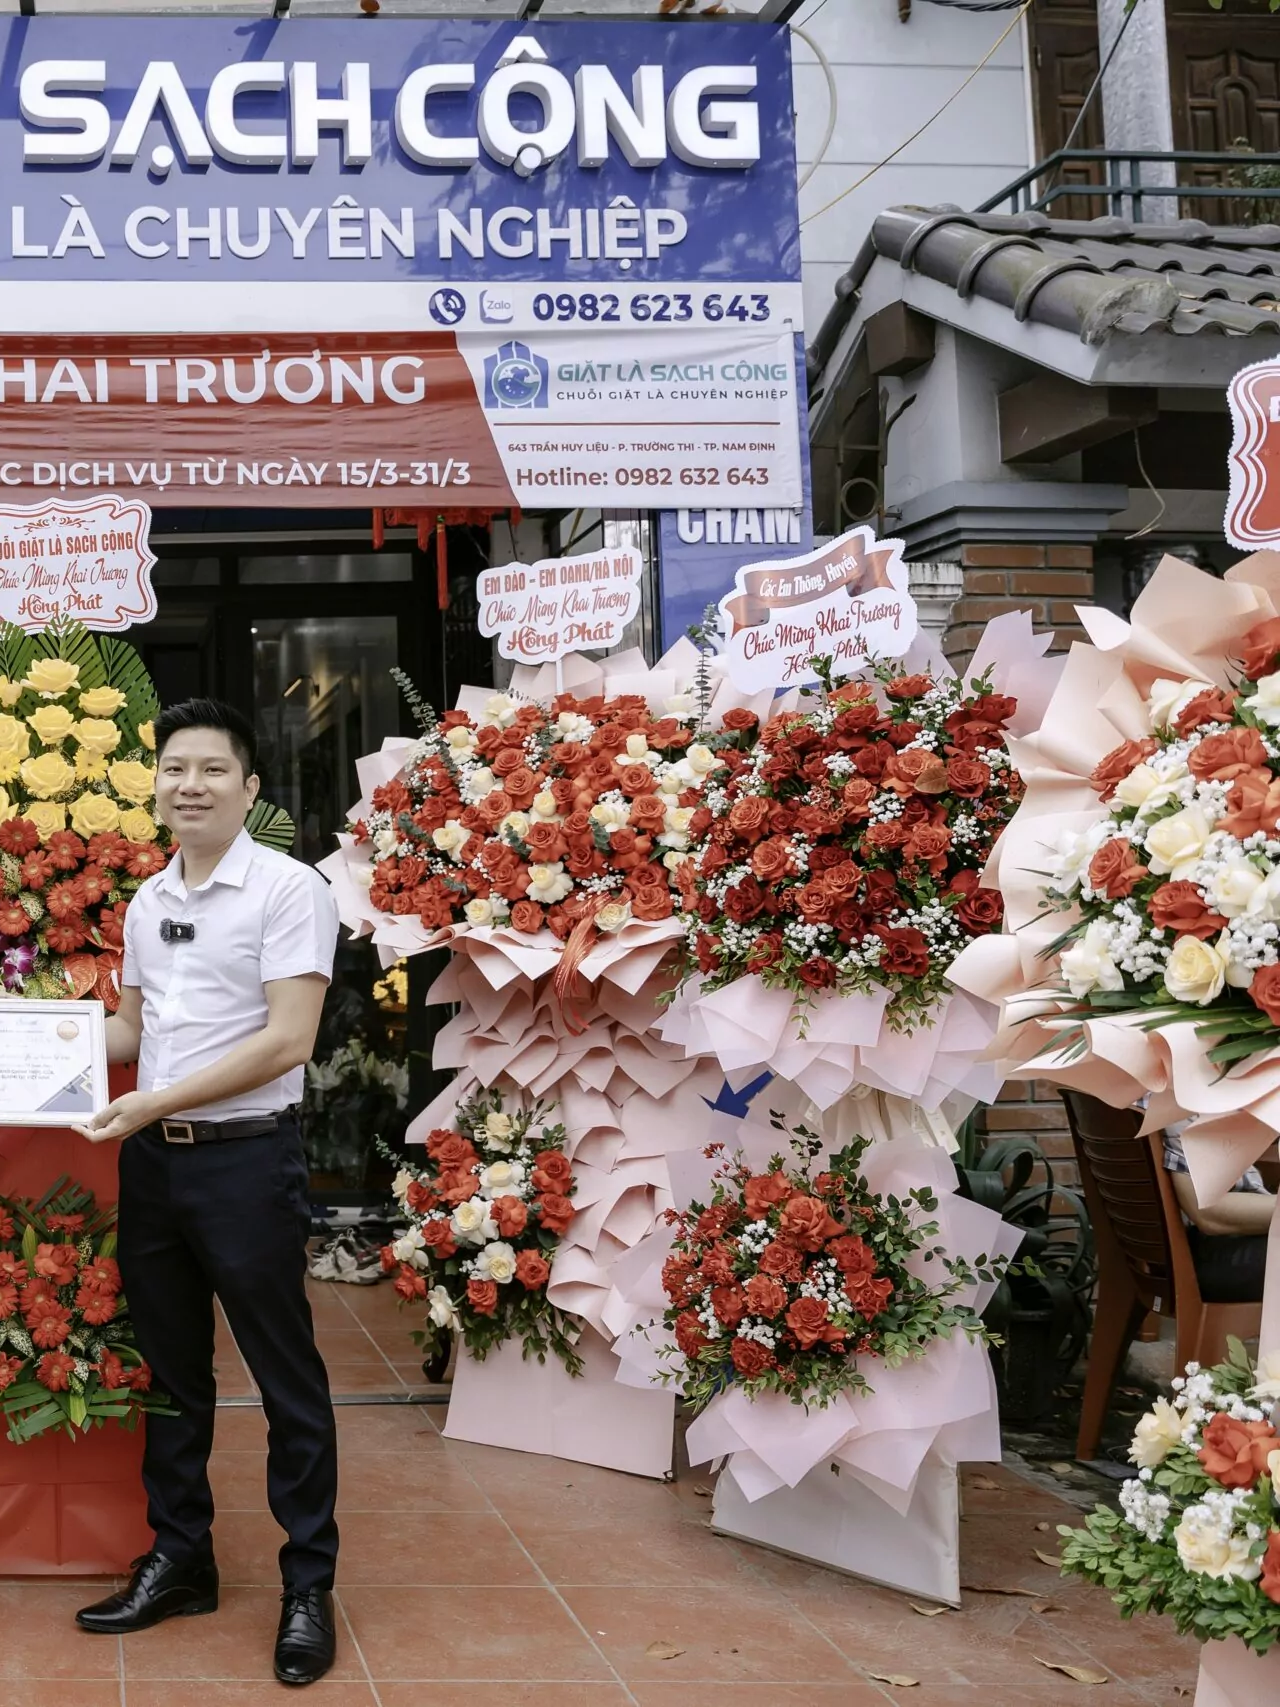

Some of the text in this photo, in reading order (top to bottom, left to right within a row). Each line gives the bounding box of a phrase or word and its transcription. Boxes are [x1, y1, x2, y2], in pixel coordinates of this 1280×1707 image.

[18, 60, 373, 177] SẠCH
[395, 35, 761, 178] CỘNG
[11, 194, 106, 259] LÀ
[123, 194, 415, 260] CHUYÊN
[438, 195, 688, 270] NGHIỆP
[486, 293, 771, 322] Zalo 0982 623 643
[131, 350, 427, 406] TRƯƠNG
[557, 360, 788, 384] GIẶT LÀ SẠCH CỘNG
[556, 388, 789, 402] CHUỖI GIẶT LÀ CHUYÊN NGHIỆP
[507, 443, 527, 453] 643
[561, 443, 584, 452] HUY
[586, 441, 609, 454] LIỆU
[618, 443, 628, 452] P.
[631, 440, 675, 452] TRƯỜNG
[677, 443, 695, 452] THI
[703, 443, 720, 452] TP.
[722, 443, 747, 451] NAM
[749, 443, 776, 454] ĐỊNH
[33, 460, 115, 492] DỊCH
[127, 460, 173, 492] VỤ
[182, 455, 228, 486] TỪ
[236, 455, 328, 486] NGÀY
[337, 460, 471, 489] 15/3-31/3
[516, 466, 770, 487] Hotline: 0982 632 643
[19, 536, 45, 561] GIẶT
[48, 534, 63, 556] LÀ
[66, 535, 97, 558] SẠCH
[101, 530, 134, 555] CỘNG
[62, 559, 88, 594] Khai
[484, 576, 501, 596] EM
[504, 570, 526, 593] ĐÀO
[539, 568, 556, 588] EM
[560, 556, 610, 585] OANH/HÀ
[613, 553, 634, 580] NỘI
[759, 578, 777, 597] Các
[777, 578, 792, 597] Em
[17, 594, 103, 621] Hồng Phát
[485, 600, 517, 628] Chúc
[560, 588, 589, 618] Khai
[506, 620, 615, 656] Hồng Phát
[744, 630, 777, 661] Chúc
[774, 623, 817, 653] Mừng
[815, 606, 852, 637] Khai
[850, 600, 903, 631] Trương
